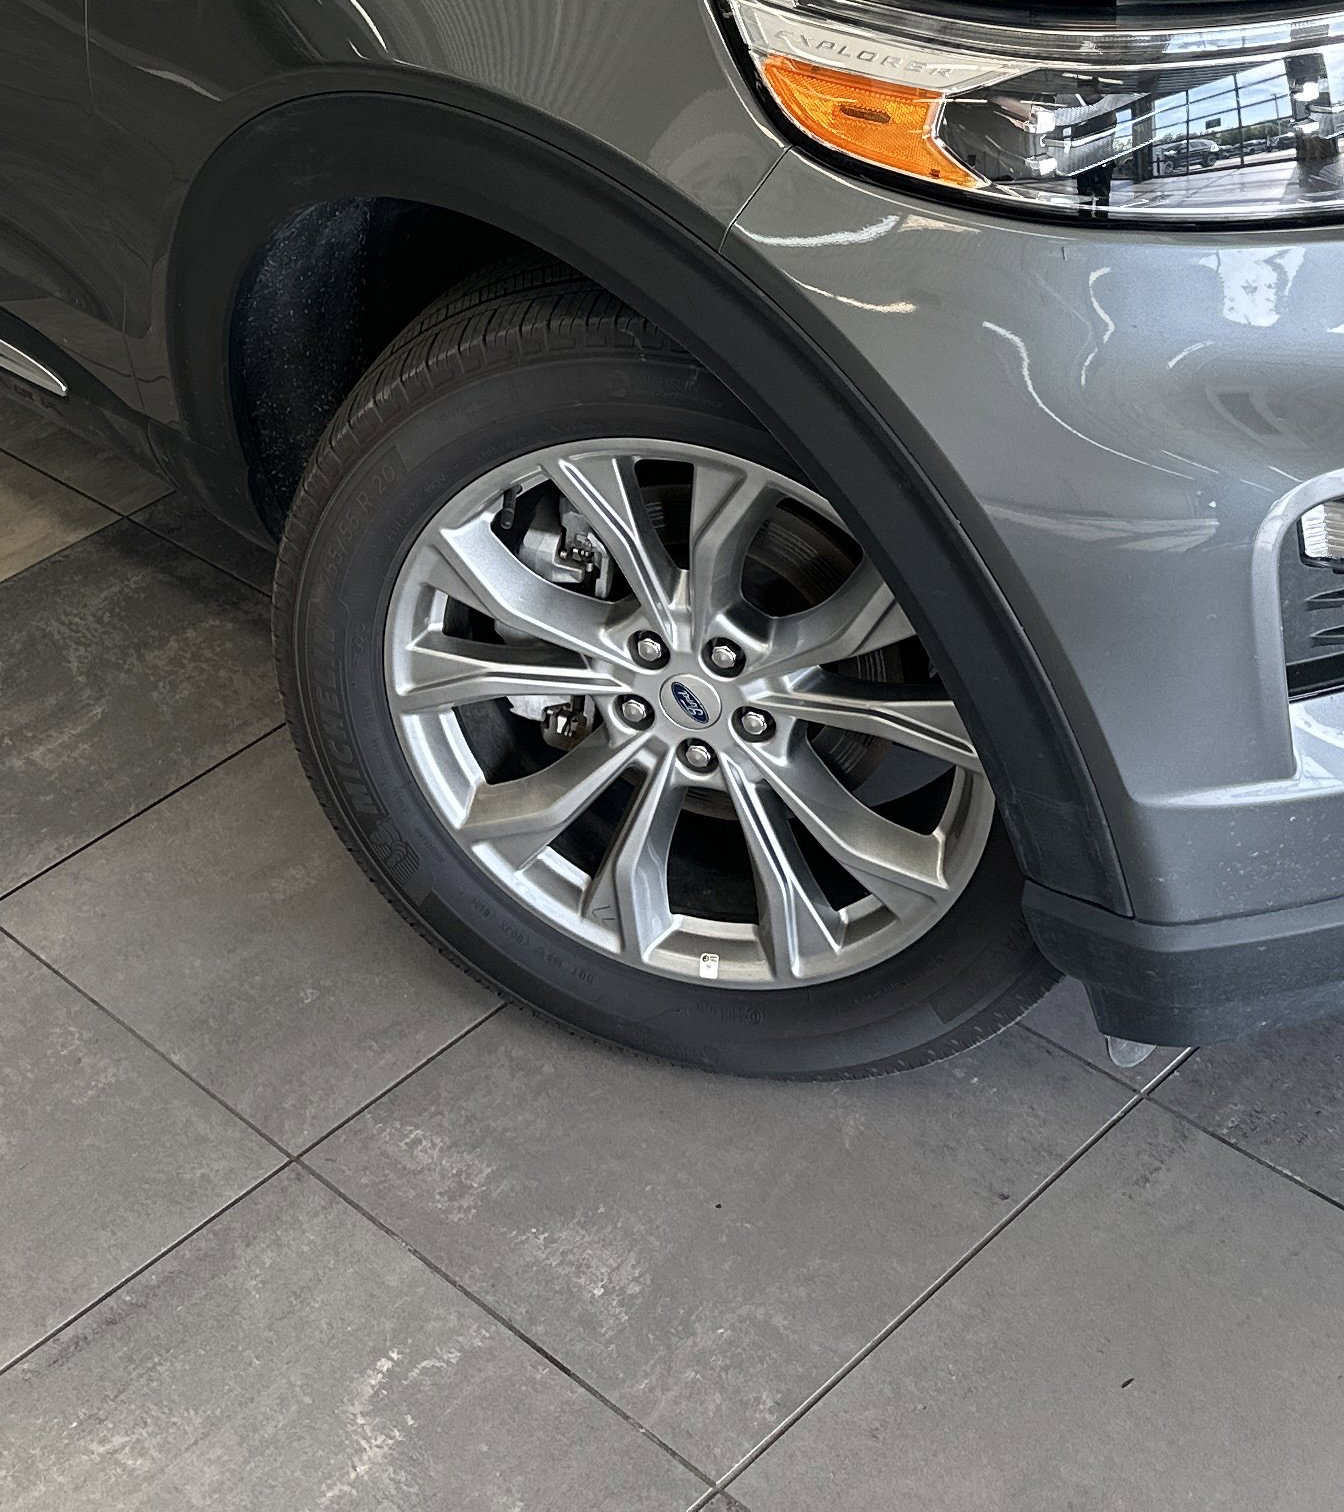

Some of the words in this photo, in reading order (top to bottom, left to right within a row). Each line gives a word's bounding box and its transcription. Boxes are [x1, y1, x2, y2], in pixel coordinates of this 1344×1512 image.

[774, 30, 953, 78] EXPLORER
[305, 614, 387, 819] MICHELIN
[353, 491, 377, 515] R
[366, 461, 401, 497] 20
[678, 691, 703, 715] Ford
